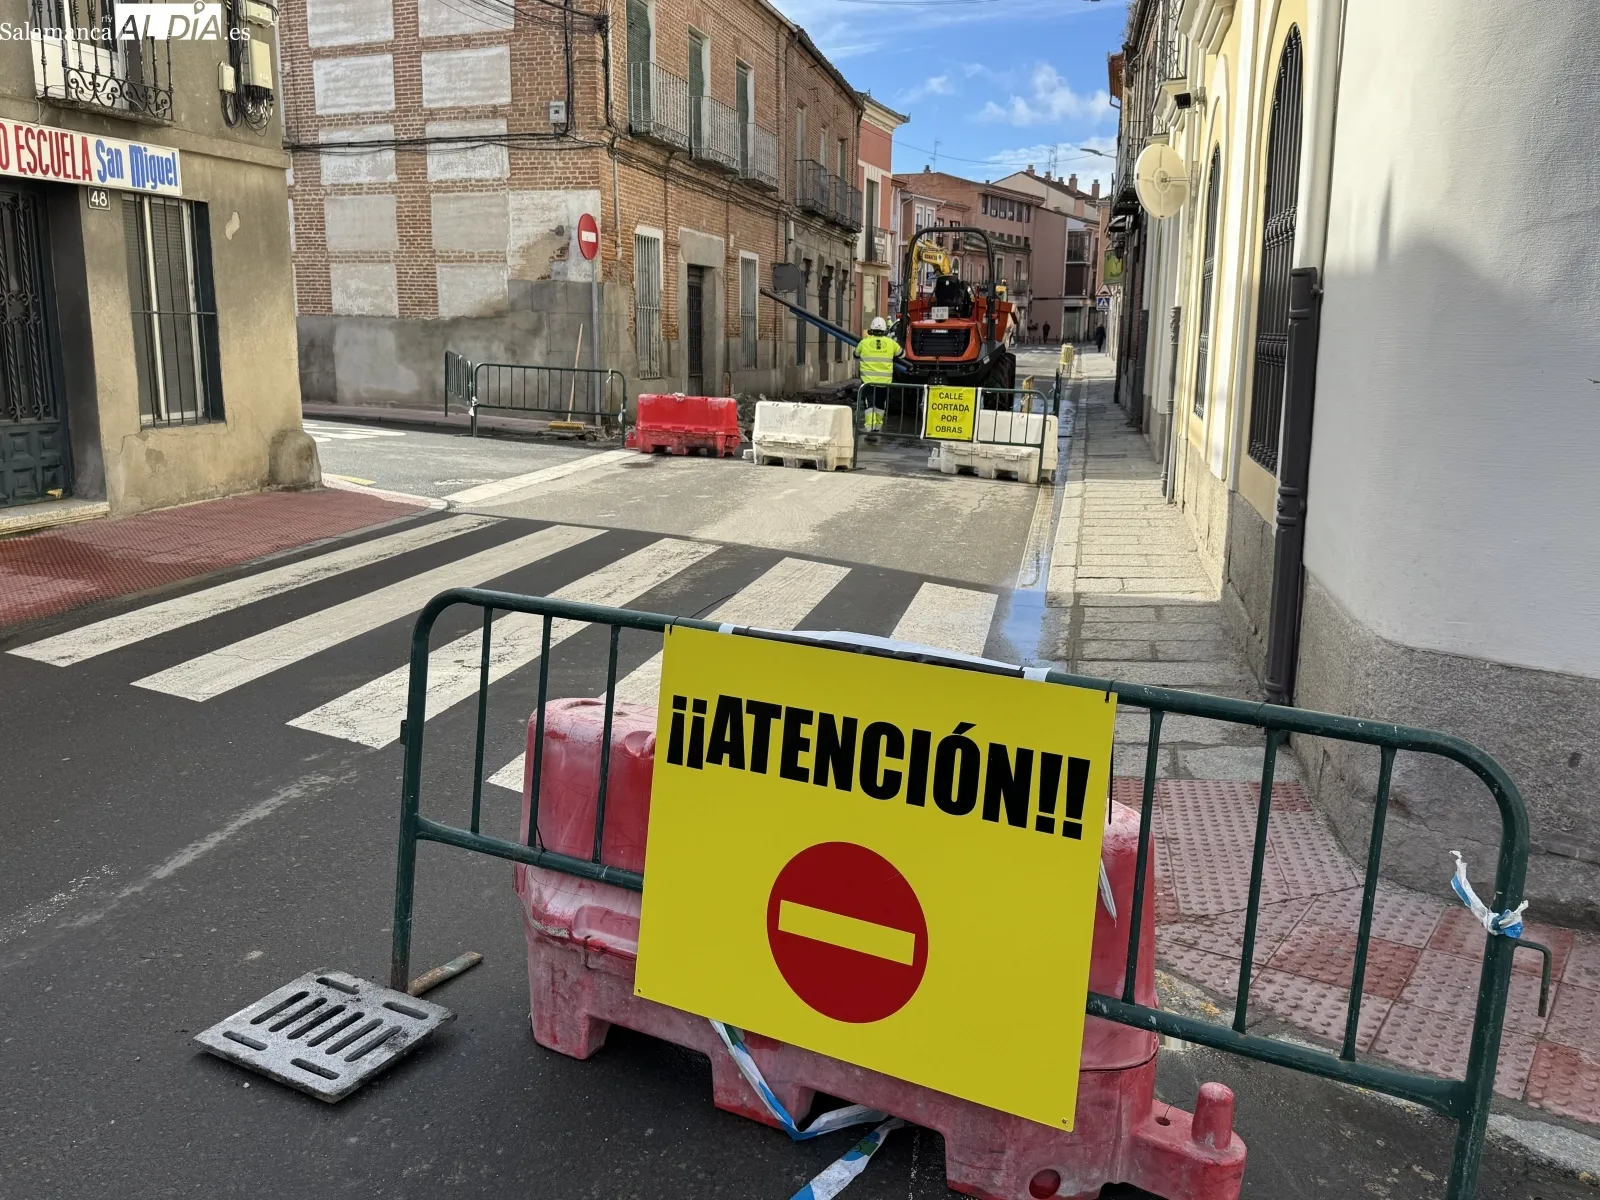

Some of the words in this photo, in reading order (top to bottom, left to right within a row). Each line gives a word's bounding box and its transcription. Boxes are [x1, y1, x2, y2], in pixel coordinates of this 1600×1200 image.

[14, 124, 93, 182] ESCUELA
[95, 139, 124, 183] San
[129, 144, 178, 190] Miguel
[90, 190, 107, 207] 48
[938, 392, 963, 400] CALLE
[931, 403, 970, 412] CORTADA
[940, 414, 958, 422] POR
[935, 425, 963, 434] OBRAS
[666, 694, 1091, 841] ¡¡ATENCIÓN!!
